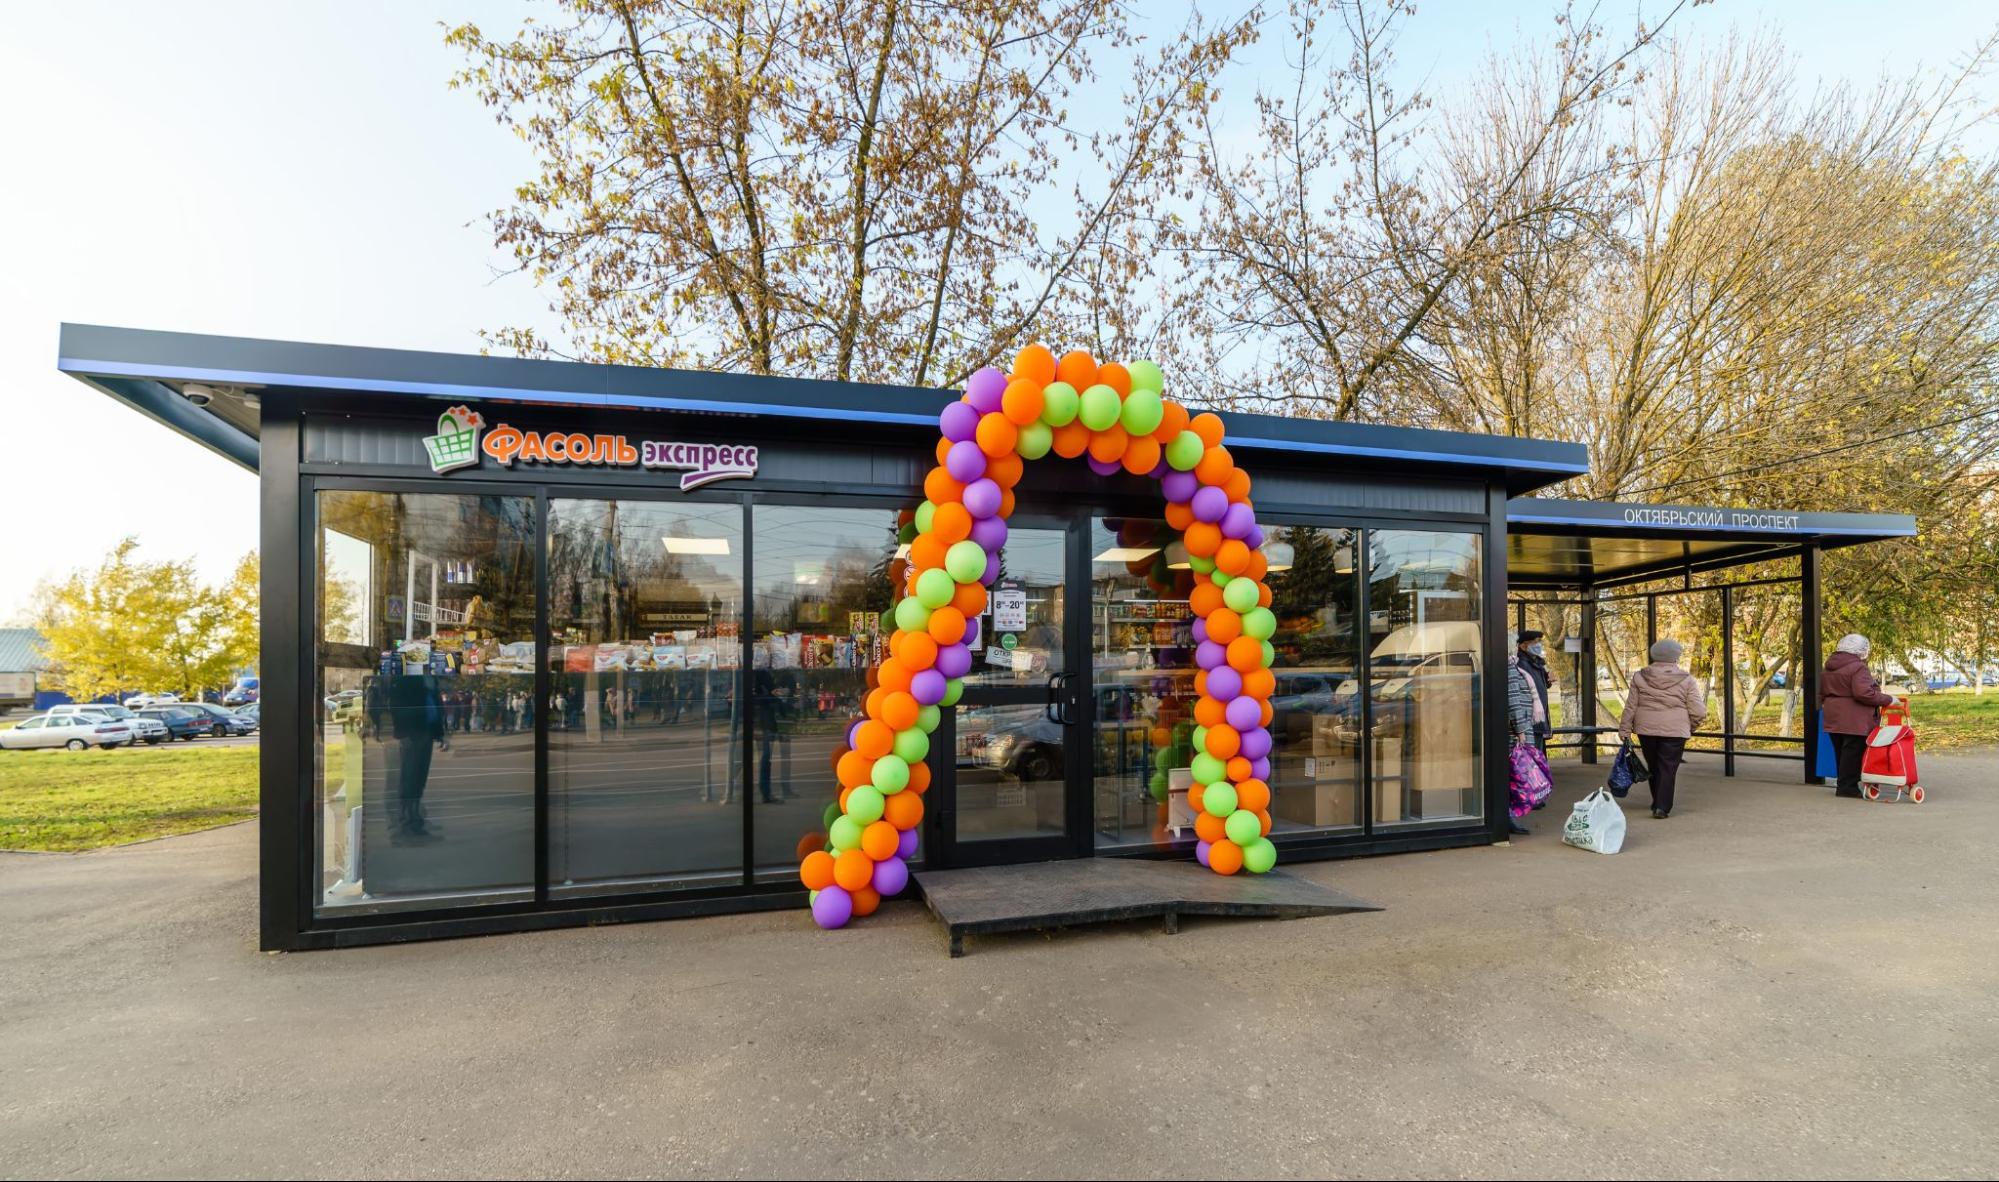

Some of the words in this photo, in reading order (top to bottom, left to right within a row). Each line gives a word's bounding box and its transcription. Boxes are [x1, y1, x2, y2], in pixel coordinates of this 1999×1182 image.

[482, 424, 638, 466] ФАСОЛЬ
[1624, 508, 1723, 527] ОКТЯБРЬСКИЙ
[1732, 513, 1799, 530] ПРОСПЕКТ
